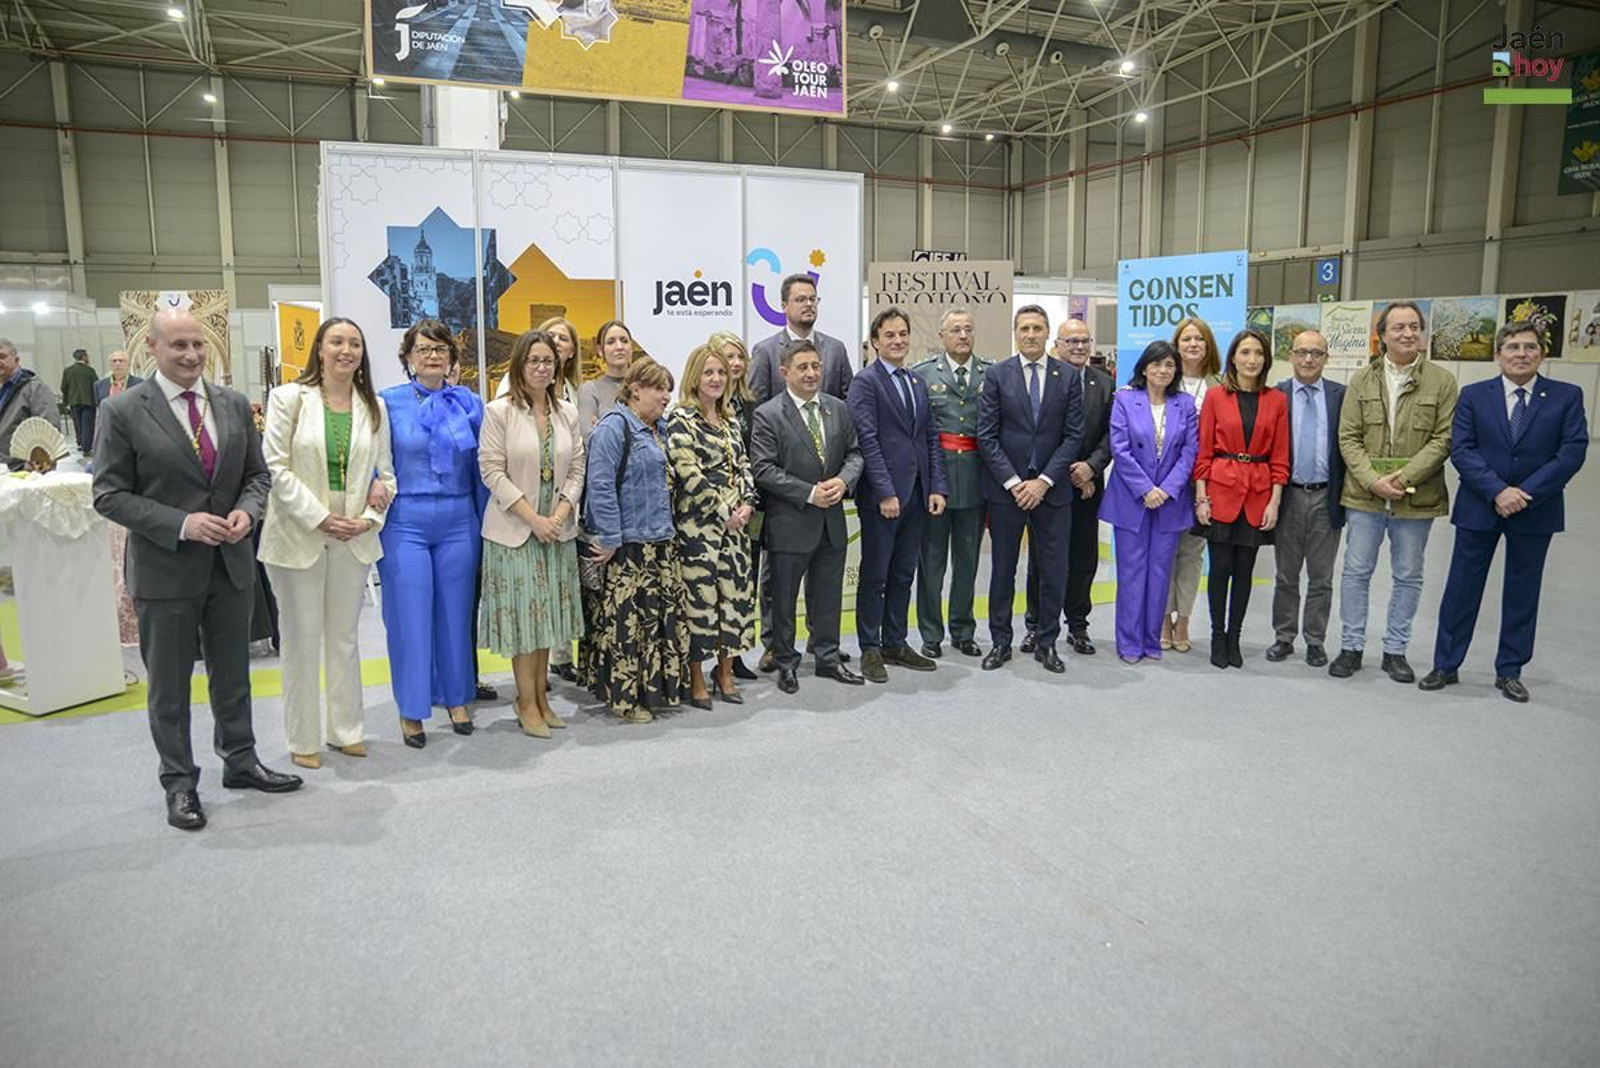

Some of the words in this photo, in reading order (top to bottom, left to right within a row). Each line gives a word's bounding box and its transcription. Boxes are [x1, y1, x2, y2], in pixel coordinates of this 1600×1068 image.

[411, 41, 425, 50] DE
[792, 60, 828, 73] OLEO
[792, 72, 827, 86] TOUR
[1322, 262, 1333, 281] 3
[881, 271, 1000, 292] FESTIVAL
[1129, 273, 1234, 301] CONSEN
[676, 308, 693, 316] está
[694, 309, 733, 318] esperando
[1129, 303, 1199, 327] TIDOS
